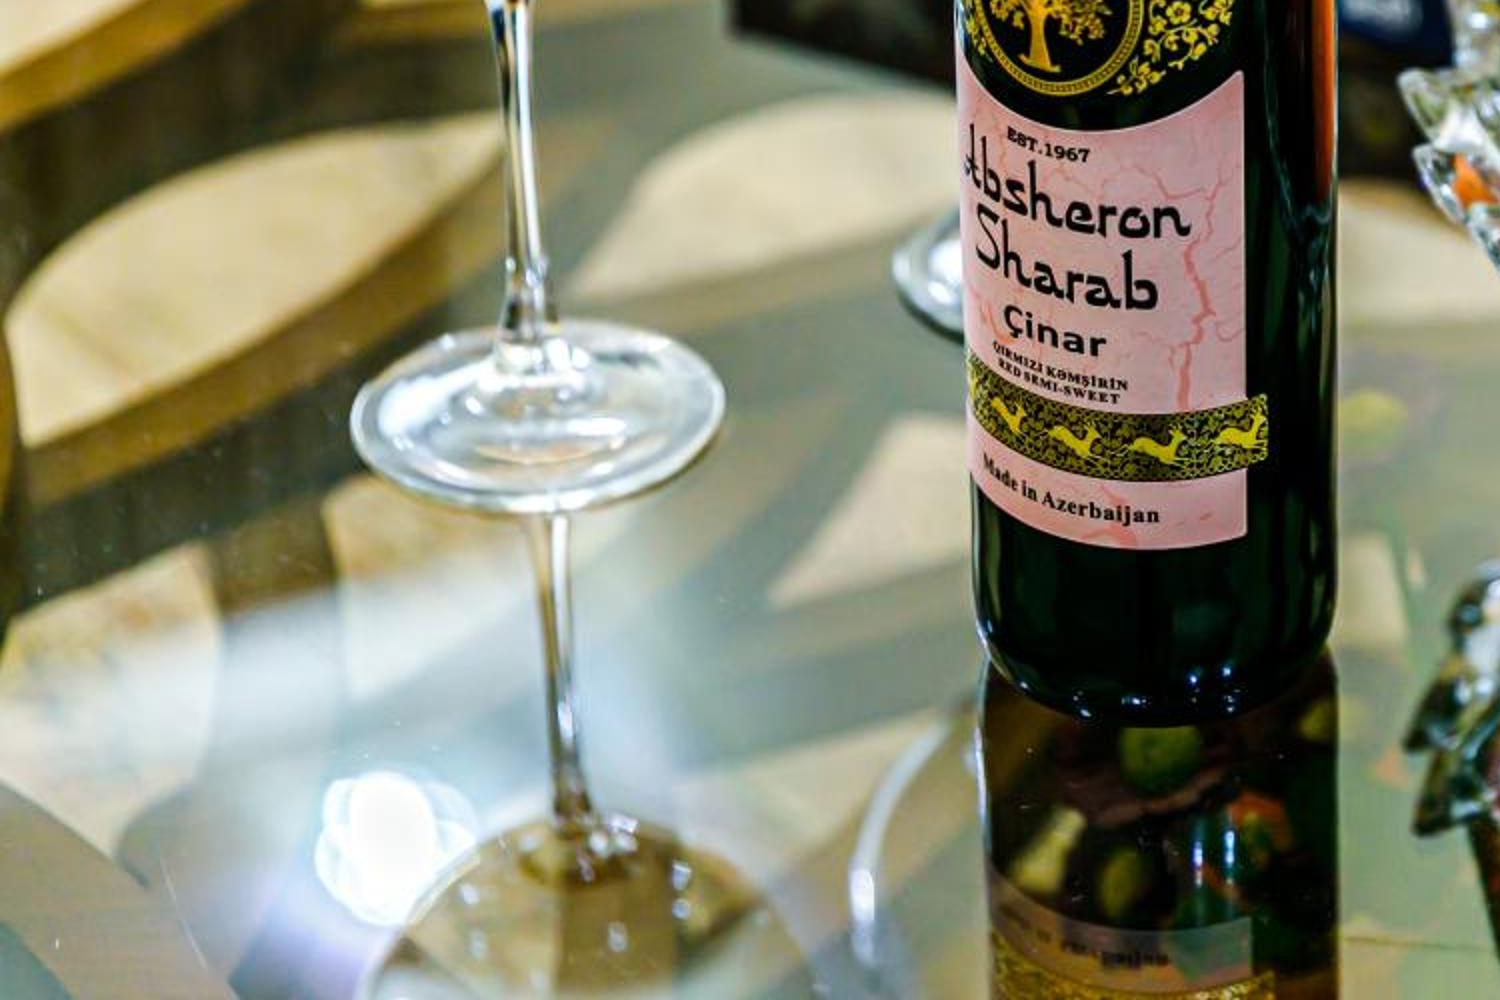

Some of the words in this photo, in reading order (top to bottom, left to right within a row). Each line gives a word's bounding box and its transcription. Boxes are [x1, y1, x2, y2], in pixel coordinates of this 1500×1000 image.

[1007, 125, 1091, 163] EST.1967
[976, 203, 1159, 311] Sharab
[1003, 304, 1107, 357] Çinar
[998, 357, 1021, 378] RED
[1023, 371, 1121, 405] SEMI-SWEET
[984, 452, 1018, 492] Made
[1021, 479, 1038, 502] in
[1041, 491, 1161, 527] Azerbaijan
